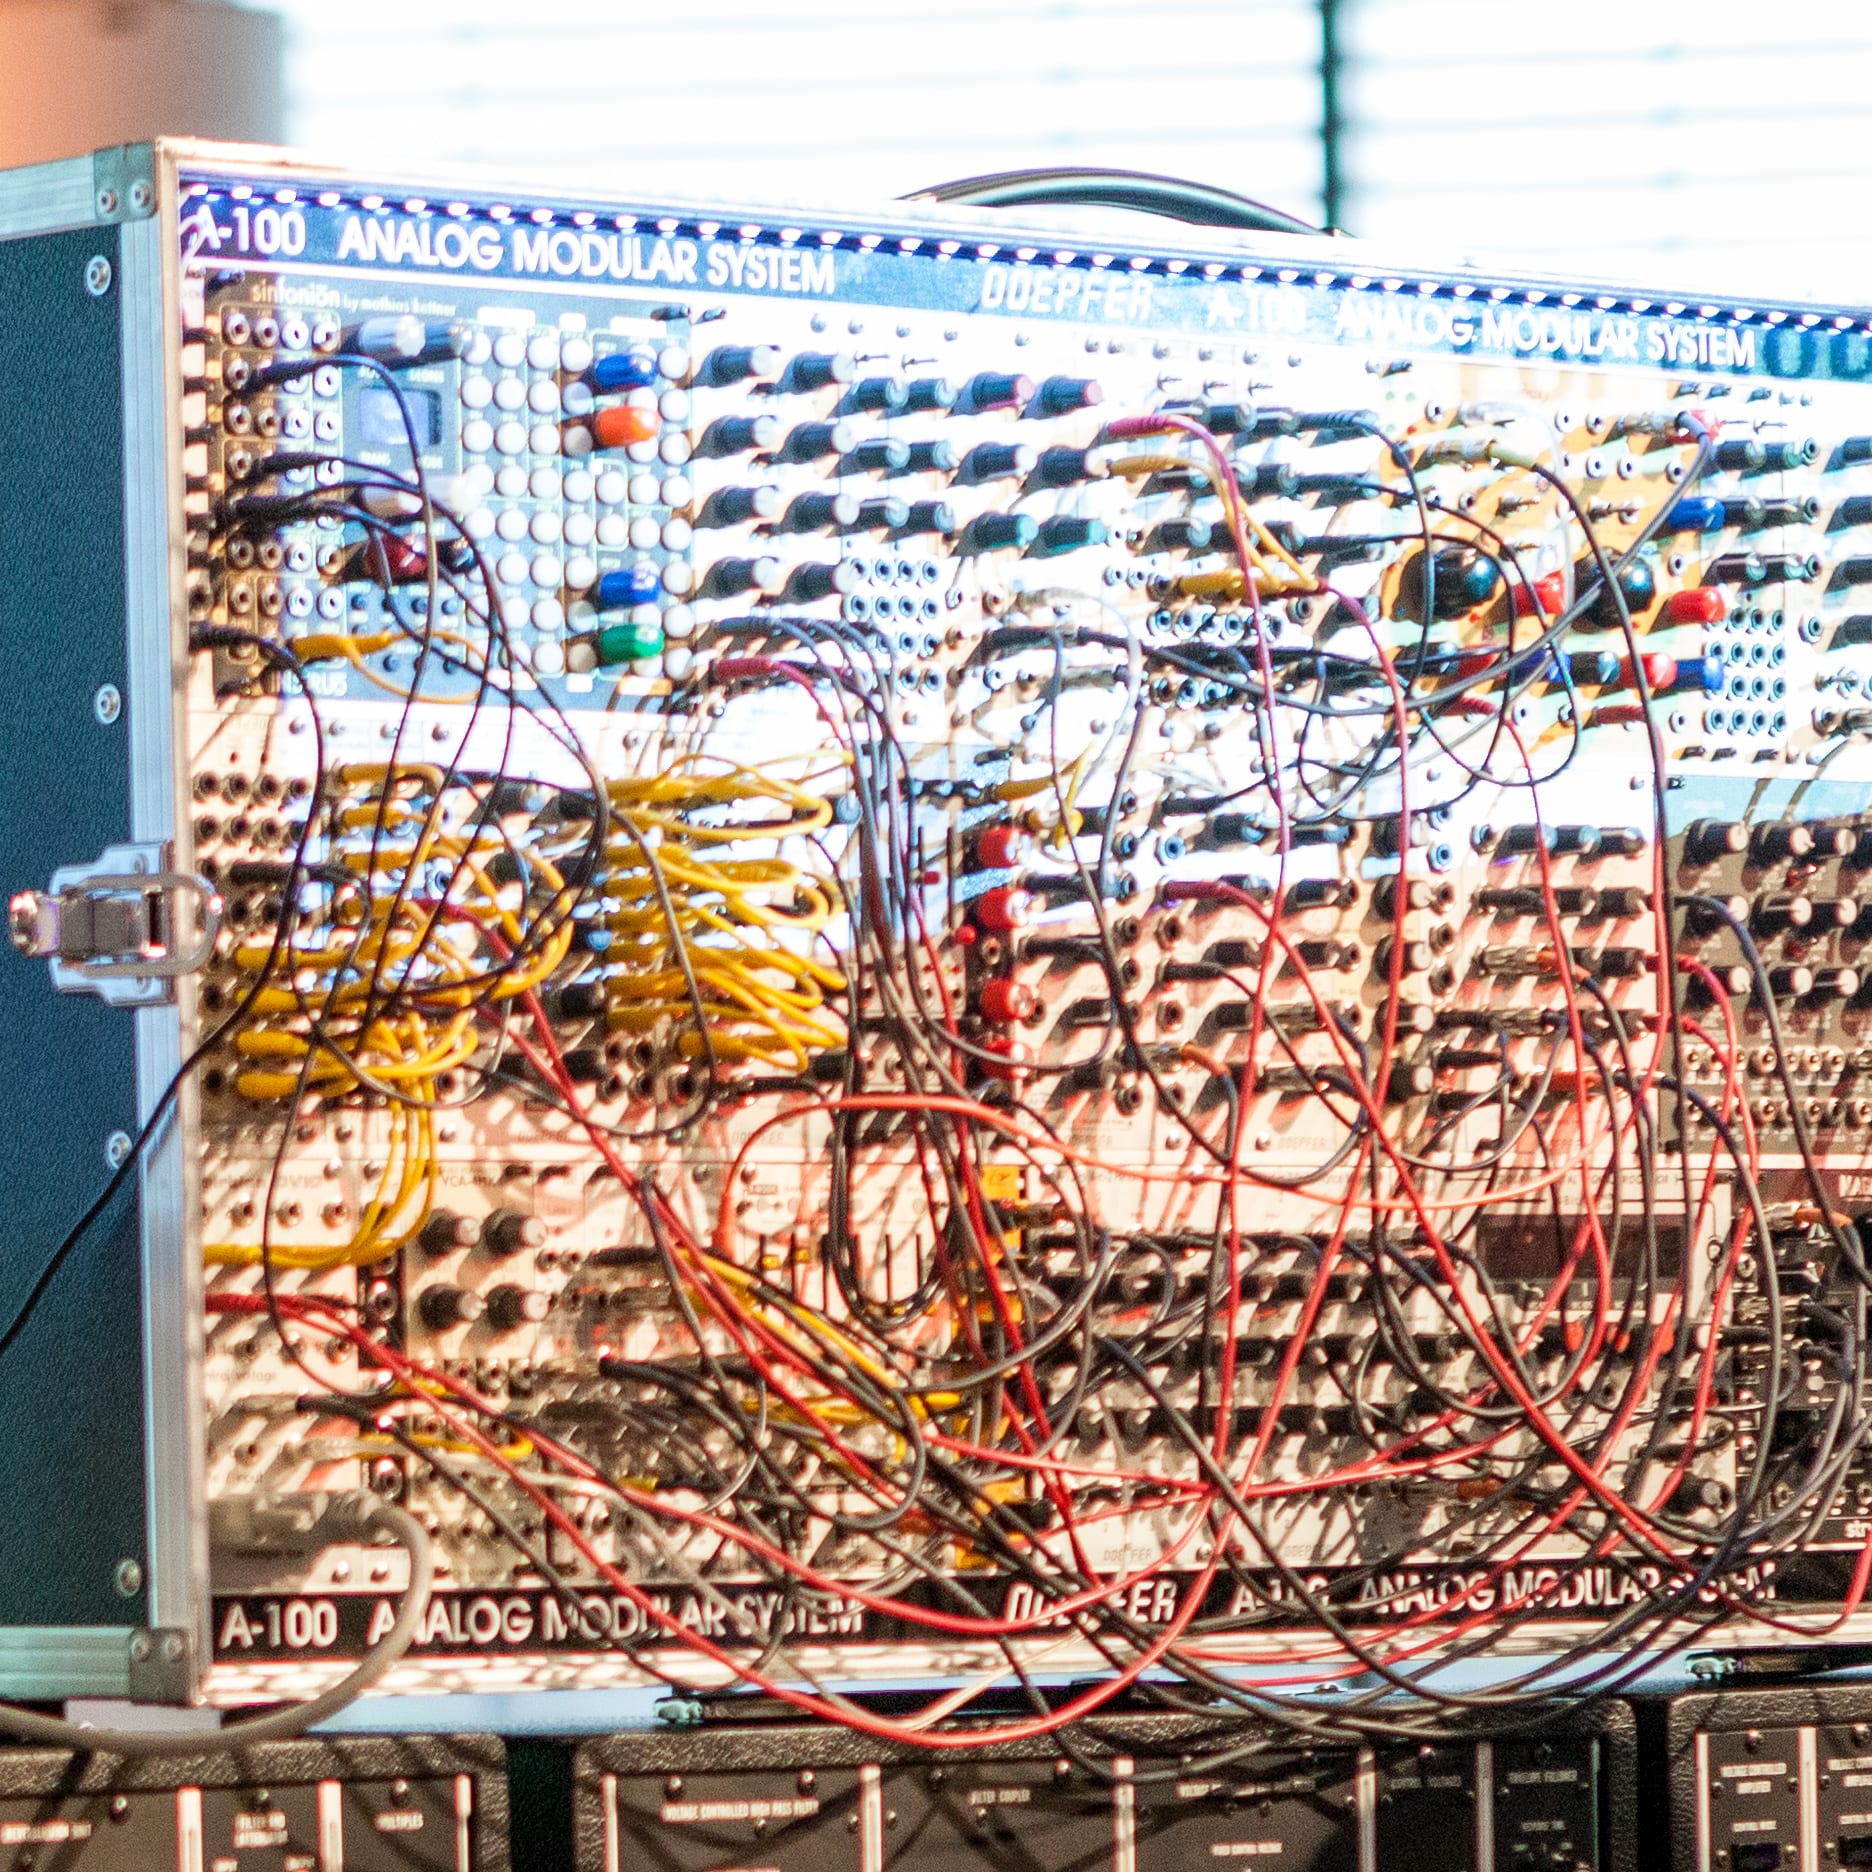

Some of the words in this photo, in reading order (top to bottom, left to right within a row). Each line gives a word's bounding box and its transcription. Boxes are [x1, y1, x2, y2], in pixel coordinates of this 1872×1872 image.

[198, 204, 306, 256] A-100
[335, 214, 504, 271] ANALOG
[511, 228, 699, 283] MODULAR
[705, 242, 836, 295] SYSTEM
[980, 265, 1154, 321] DOEPFER
[1333, 296, 1474, 347] ANALOG
[1482, 307, 1640, 359] MODULAR
[1647, 321, 1756, 368] SYSTEM
[218, 1598, 339, 1648] A-100
